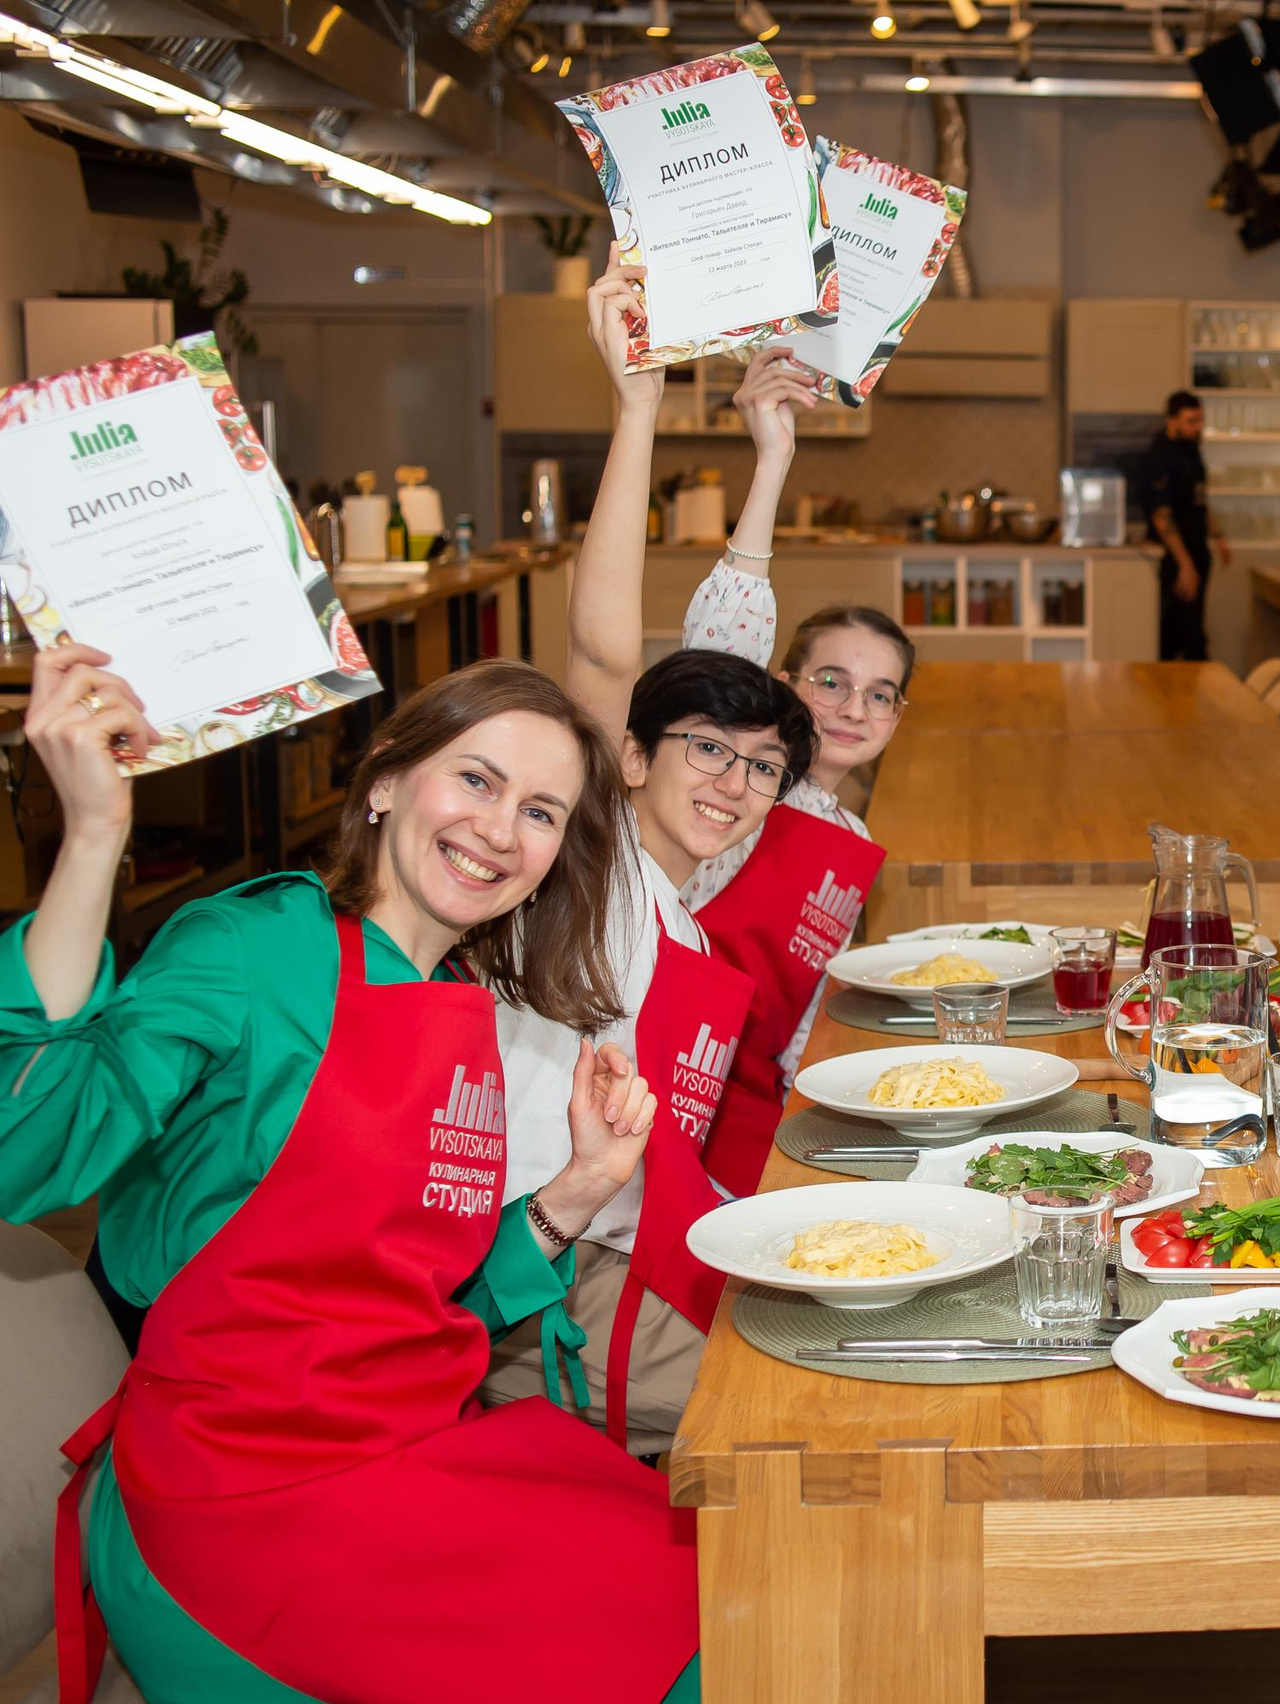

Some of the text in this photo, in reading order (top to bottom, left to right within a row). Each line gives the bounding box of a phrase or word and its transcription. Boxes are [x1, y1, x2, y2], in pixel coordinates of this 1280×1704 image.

[661, 101, 711, 130] Julia
[664, 118, 715, 139] VYSOTSKAYA
[660, 143, 748, 184] ДИПЛОМ
[647, 187, 680, 199] УЧАСТНИКА
[682, 174, 723, 189] КУЛИНАРНОГО
[859, 193, 898, 219] Julia
[649, 240, 680, 251] «Вителло
[681, 233, 710, 244] Тоннато,
[711, 223, 748, 236] Тальятелле
[70, 421, 138, 460] Julia
[67, 472, 192, 529] ДИПЛОМ
[676, 1022, 739, 1082] Jul
[432, 1064, 505, 1135] Julia
[672, 1064, 724, 1102] VYSOTS
[429, 1126, 504, 1162] VYSOTSKAYA
[428, 1161, 496, 1187] КУЛИНАРНАЯ
[422, 1181, 494, 1218] СТУДИЯ
